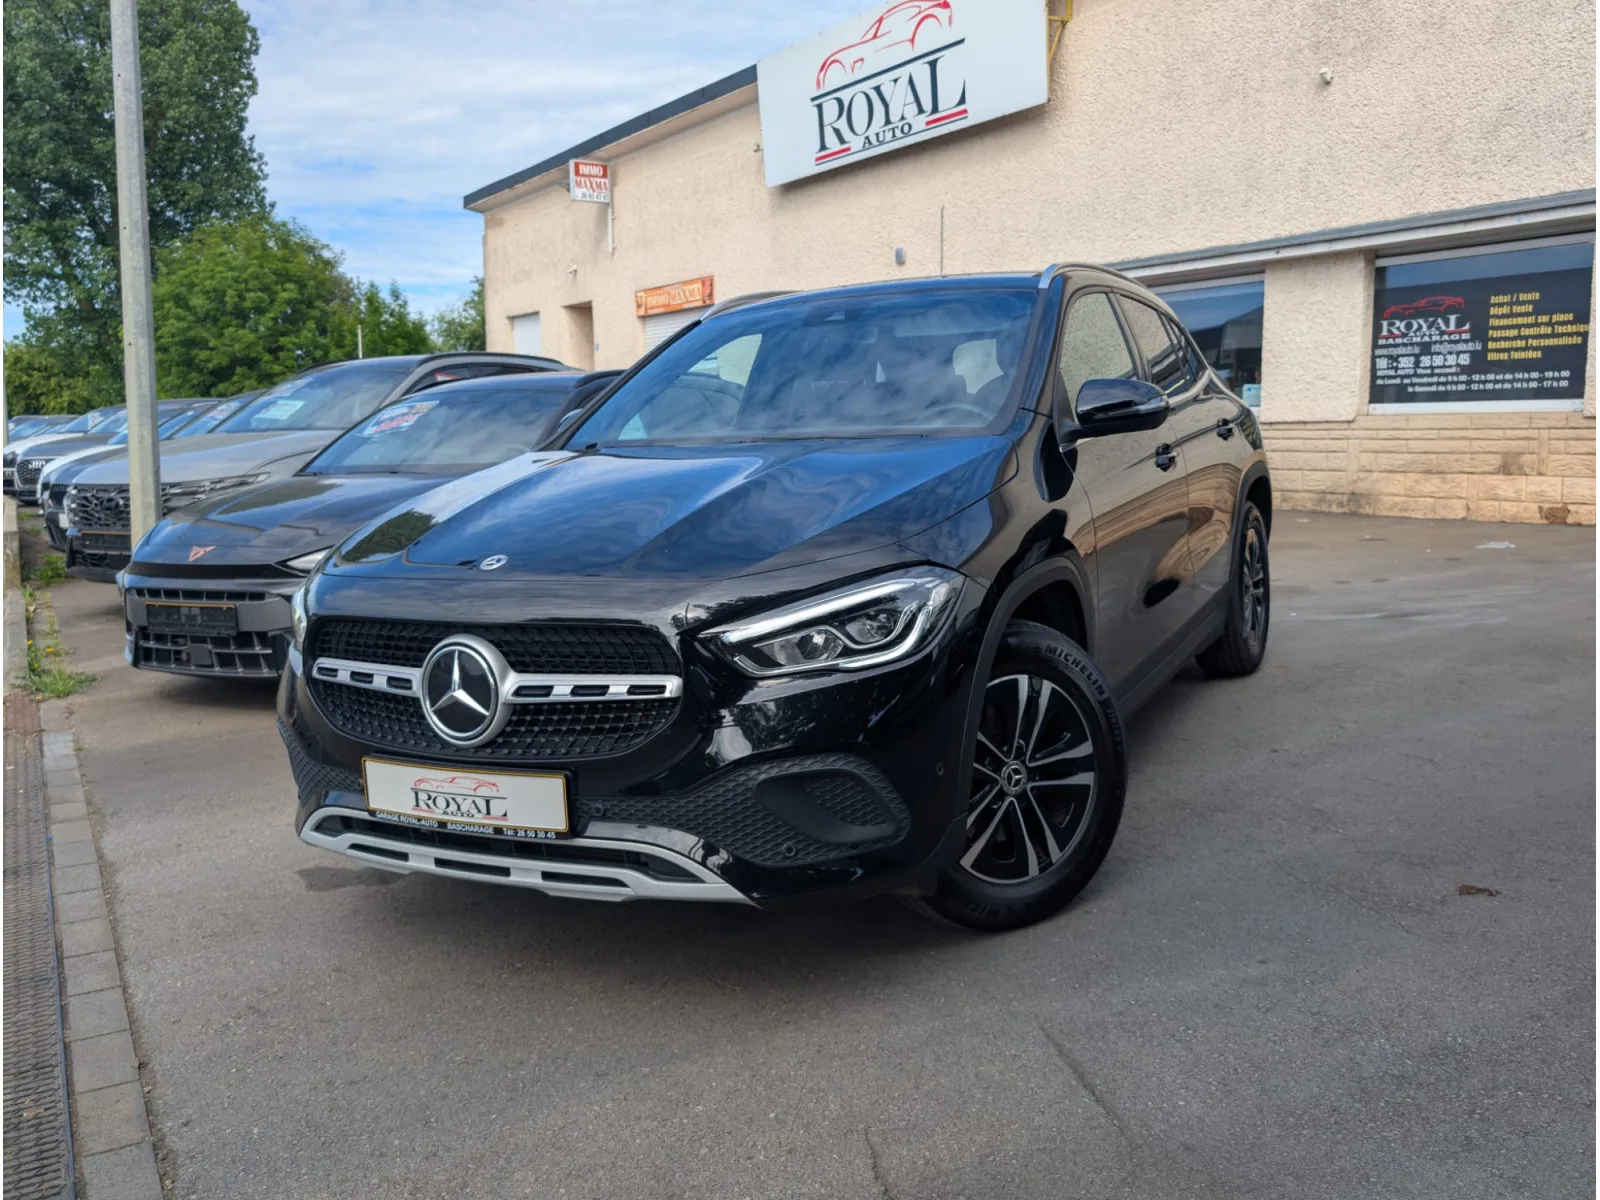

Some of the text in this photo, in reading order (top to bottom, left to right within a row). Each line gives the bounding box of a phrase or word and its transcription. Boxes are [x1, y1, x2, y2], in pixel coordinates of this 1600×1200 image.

[812, 55, 966, 154] ROYAL
[862, 122, 913, 148] AUTO
[579, 163, 604, 177] IMMO
[575, 177, 608, 193] MAXMA
[646, 293, 669, 307] IMMO
[669, 285, 702, 305] MAXMA
[1490, 294, 1511, 304] Achat
[1519, 292, 1540, 301] Vente
[1512, 304, 1533, 313] Vente
[1380, 314, 1471, 335] ROYAL
[1489, 313, 1574, 327] Financement sur place
[1378, 333, 1471, 345] BASCHARAGE
[1408, 328, 1440, 337] AUTO
[1488, 329, 1518, 338] Passage
[1488, 340, 1526, 350] Recherche
[1420, 355, 1431, 367] 26
[1432, 354, 1443, 367] 50
[1445, 353, 1456, 366] 30
[1458, 353, 1470, 365] 45
[1487, 352, 1508, 360] Vitres
[1397, 368, 1414, 376] AUTO
[1044, 643, 1106, 697] MICHELIN
[413, 791, 508, 817] ROYAL
[376, 811, 399, 822] GARAGE
[447, 822, 494, 834] BASCHARAGE
[517, 829, 525, 837] 26
[547, 831, 556, 839] 45
